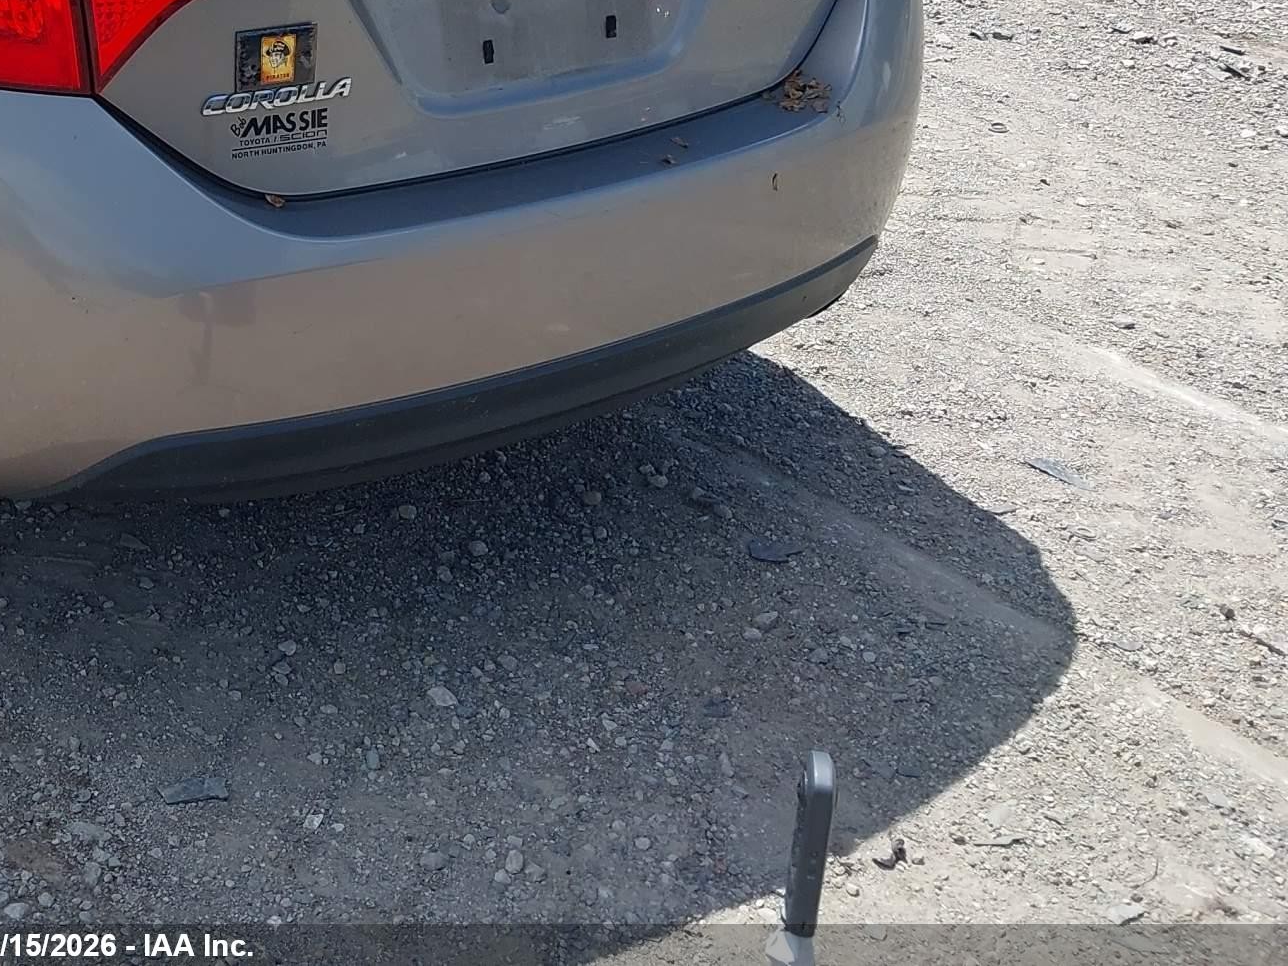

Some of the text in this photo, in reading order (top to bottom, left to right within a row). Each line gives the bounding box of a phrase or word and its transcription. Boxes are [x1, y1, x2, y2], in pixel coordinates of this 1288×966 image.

[201, 77, 353, 117] COROLLA
[230, 107, 328, 139] Bob MASSIE
[232, 149, 259, 159] NORTH
[317, 140, 327, 148] PA
[240, 137, 270, 146] TOYOTA
